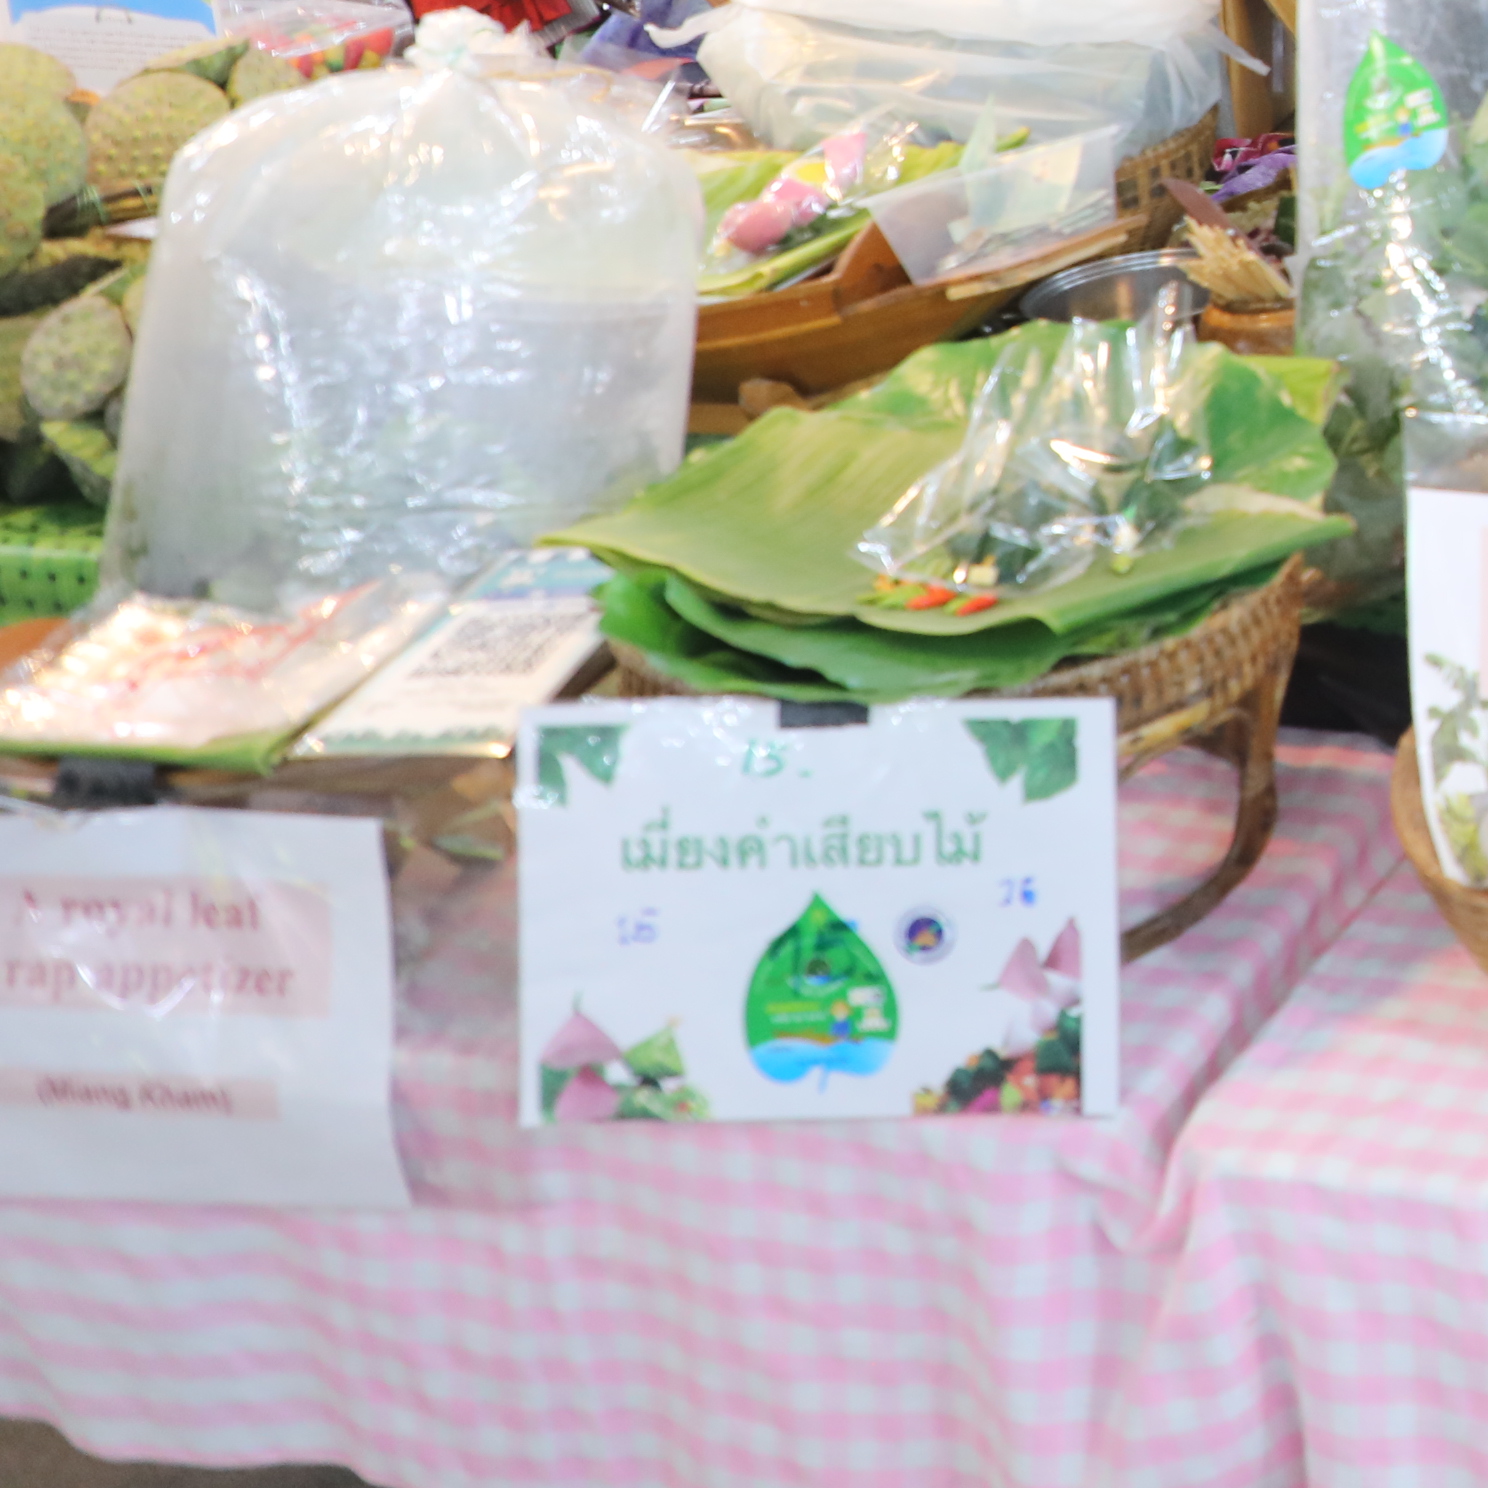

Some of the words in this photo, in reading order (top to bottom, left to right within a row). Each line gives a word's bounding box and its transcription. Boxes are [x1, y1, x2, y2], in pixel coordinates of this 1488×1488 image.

[620, 805, 985, 872] เมี่ยงคำเสียบไม้
